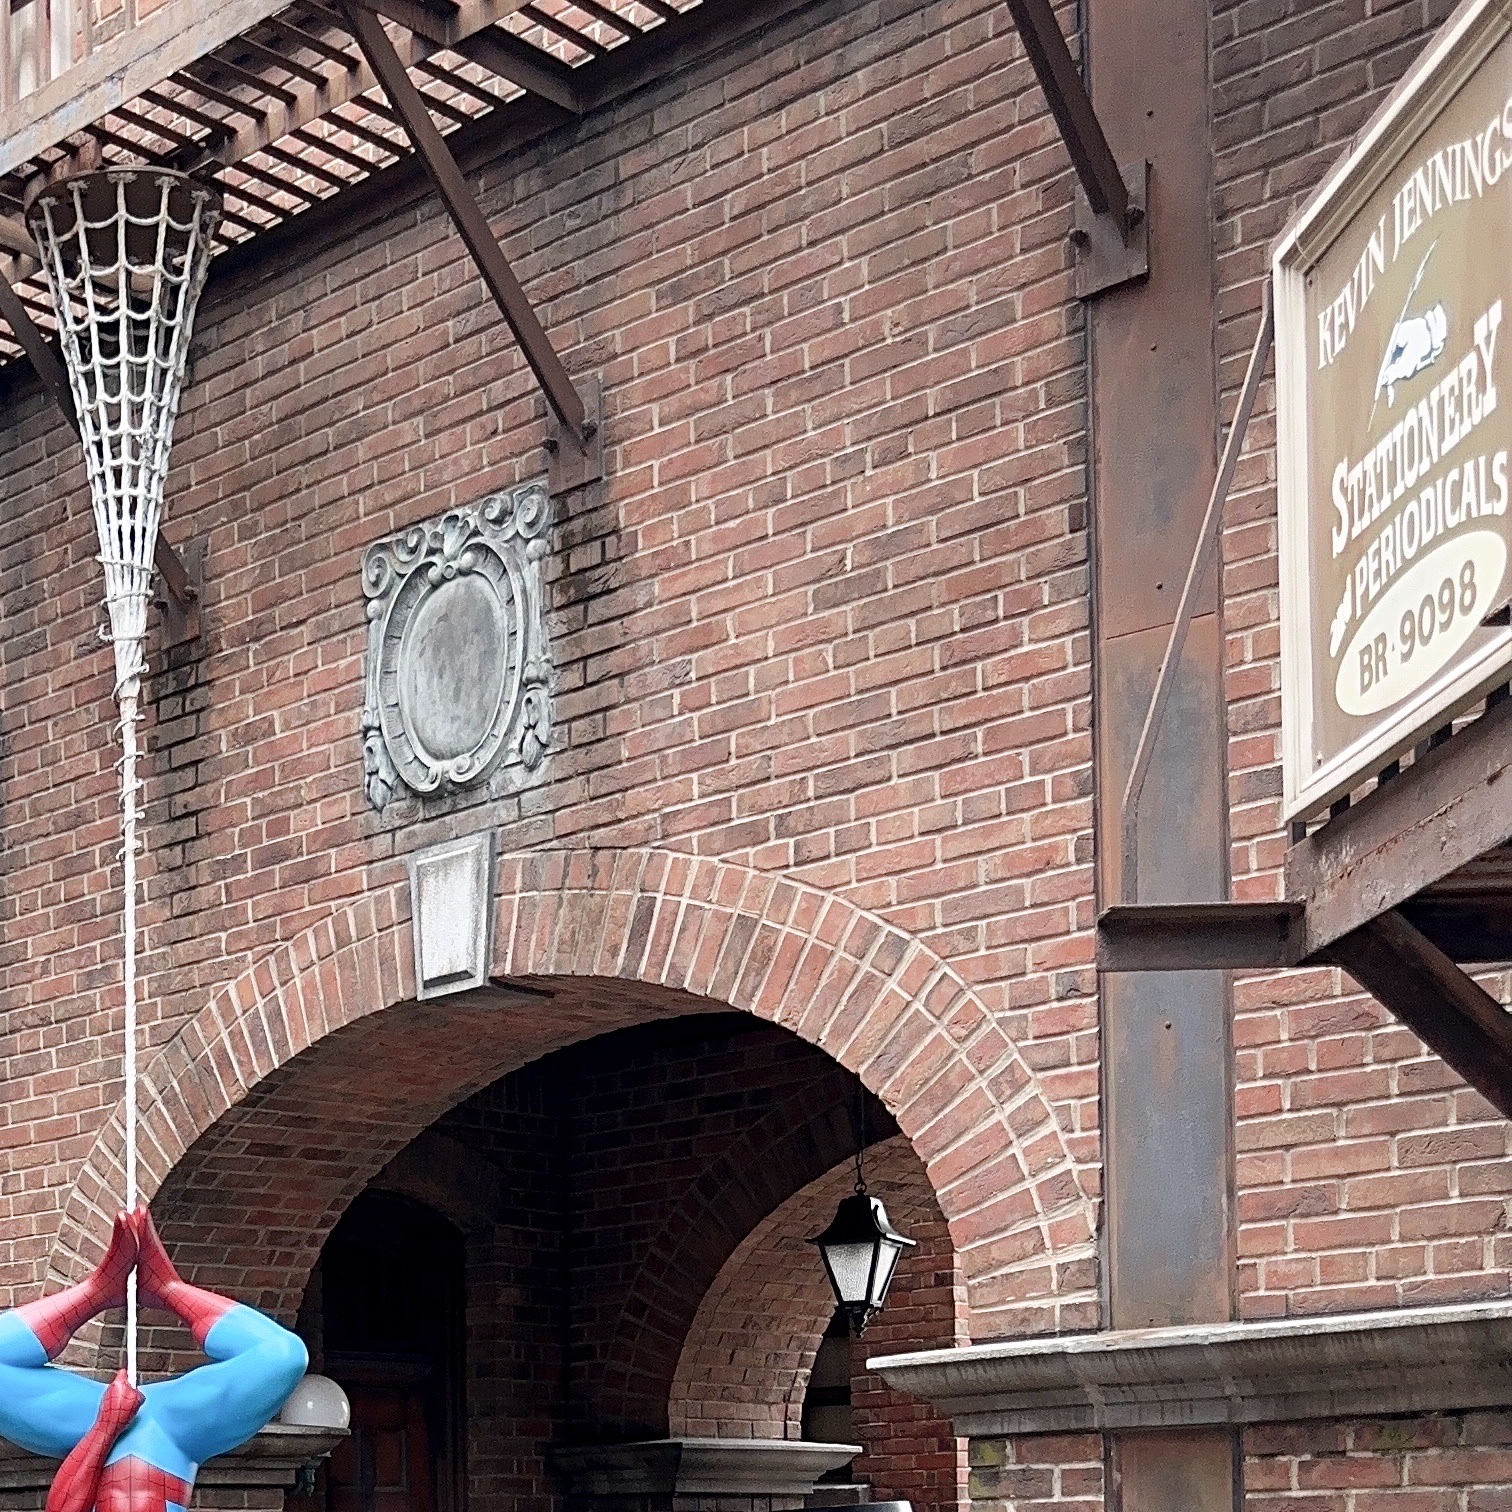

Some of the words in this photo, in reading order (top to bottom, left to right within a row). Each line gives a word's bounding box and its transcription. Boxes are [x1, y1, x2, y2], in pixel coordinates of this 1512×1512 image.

[1318, 213, 1386, 370] KEVIN
[1392, 96, 1512, 262] JENNINGS
[1331, 299, 1503, 558] STATIONERY
[1354, 451, 1508, 620] PERIODICALS
